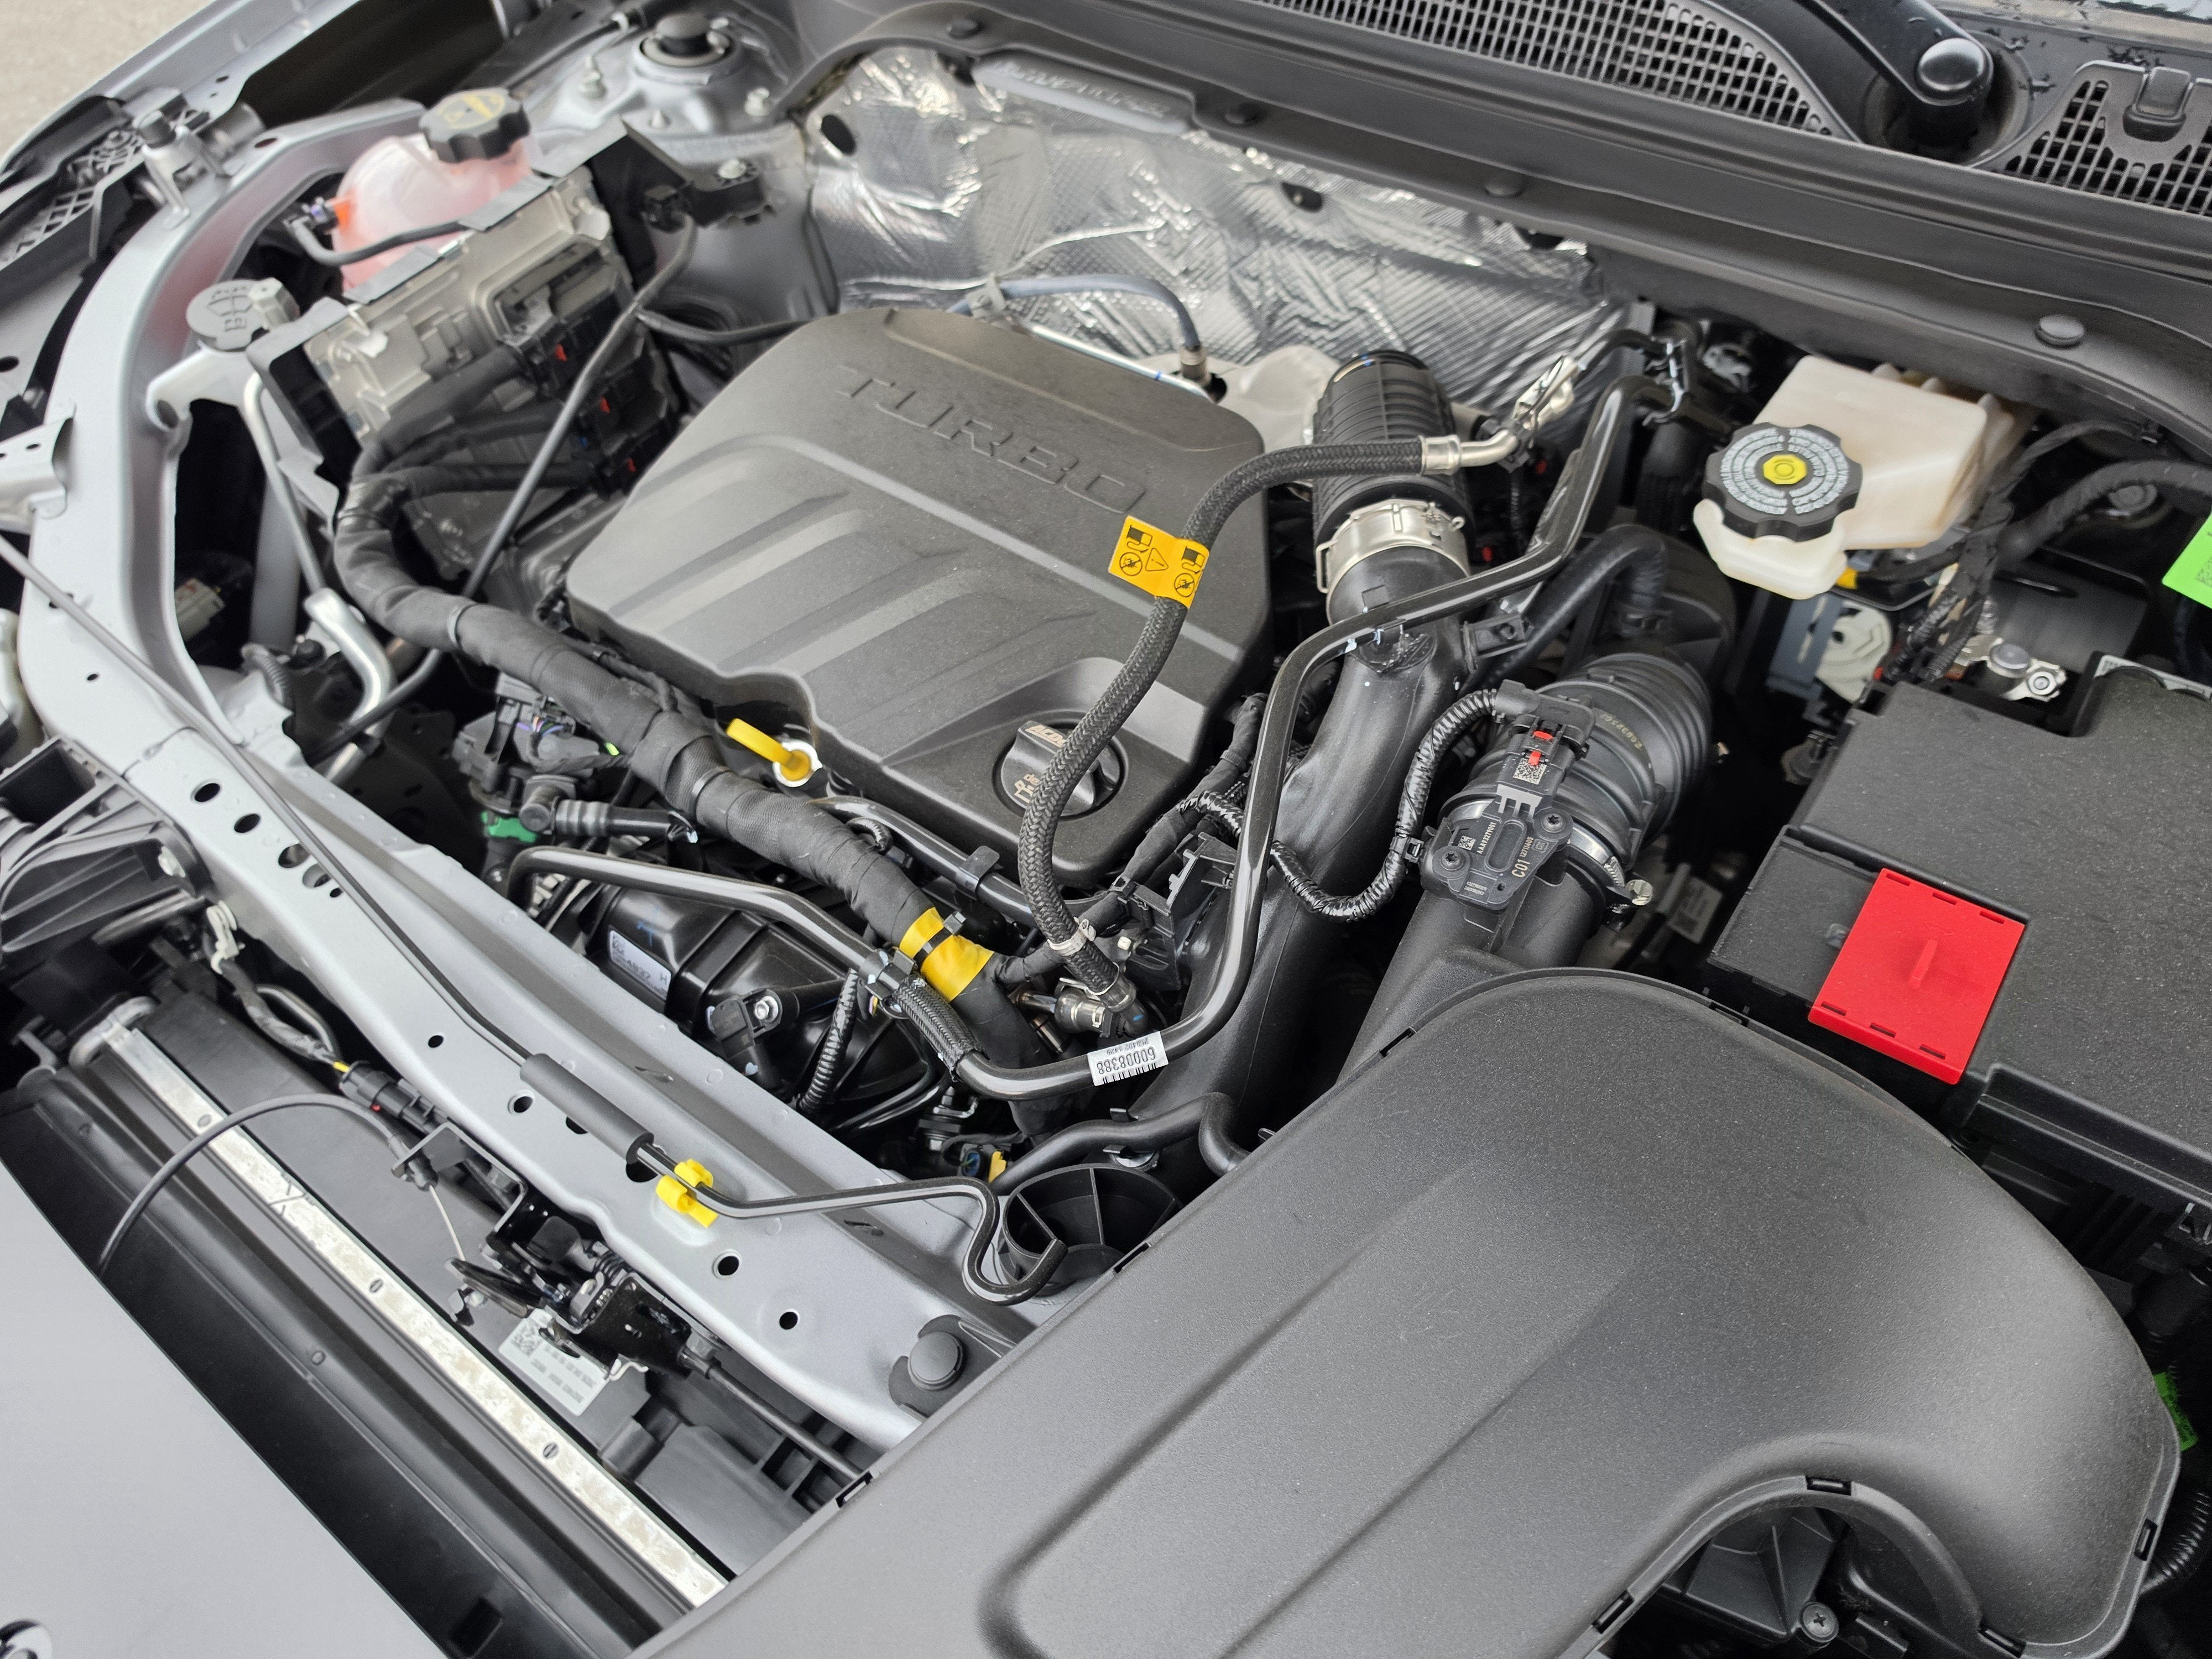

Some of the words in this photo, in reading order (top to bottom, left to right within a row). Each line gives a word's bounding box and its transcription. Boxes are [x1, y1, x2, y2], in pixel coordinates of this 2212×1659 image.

[834, 366, 1146, 514] TURBO
[1511, 859, 1531, 878] C01
[1097, 1046, 1156, 1074] 60008388
